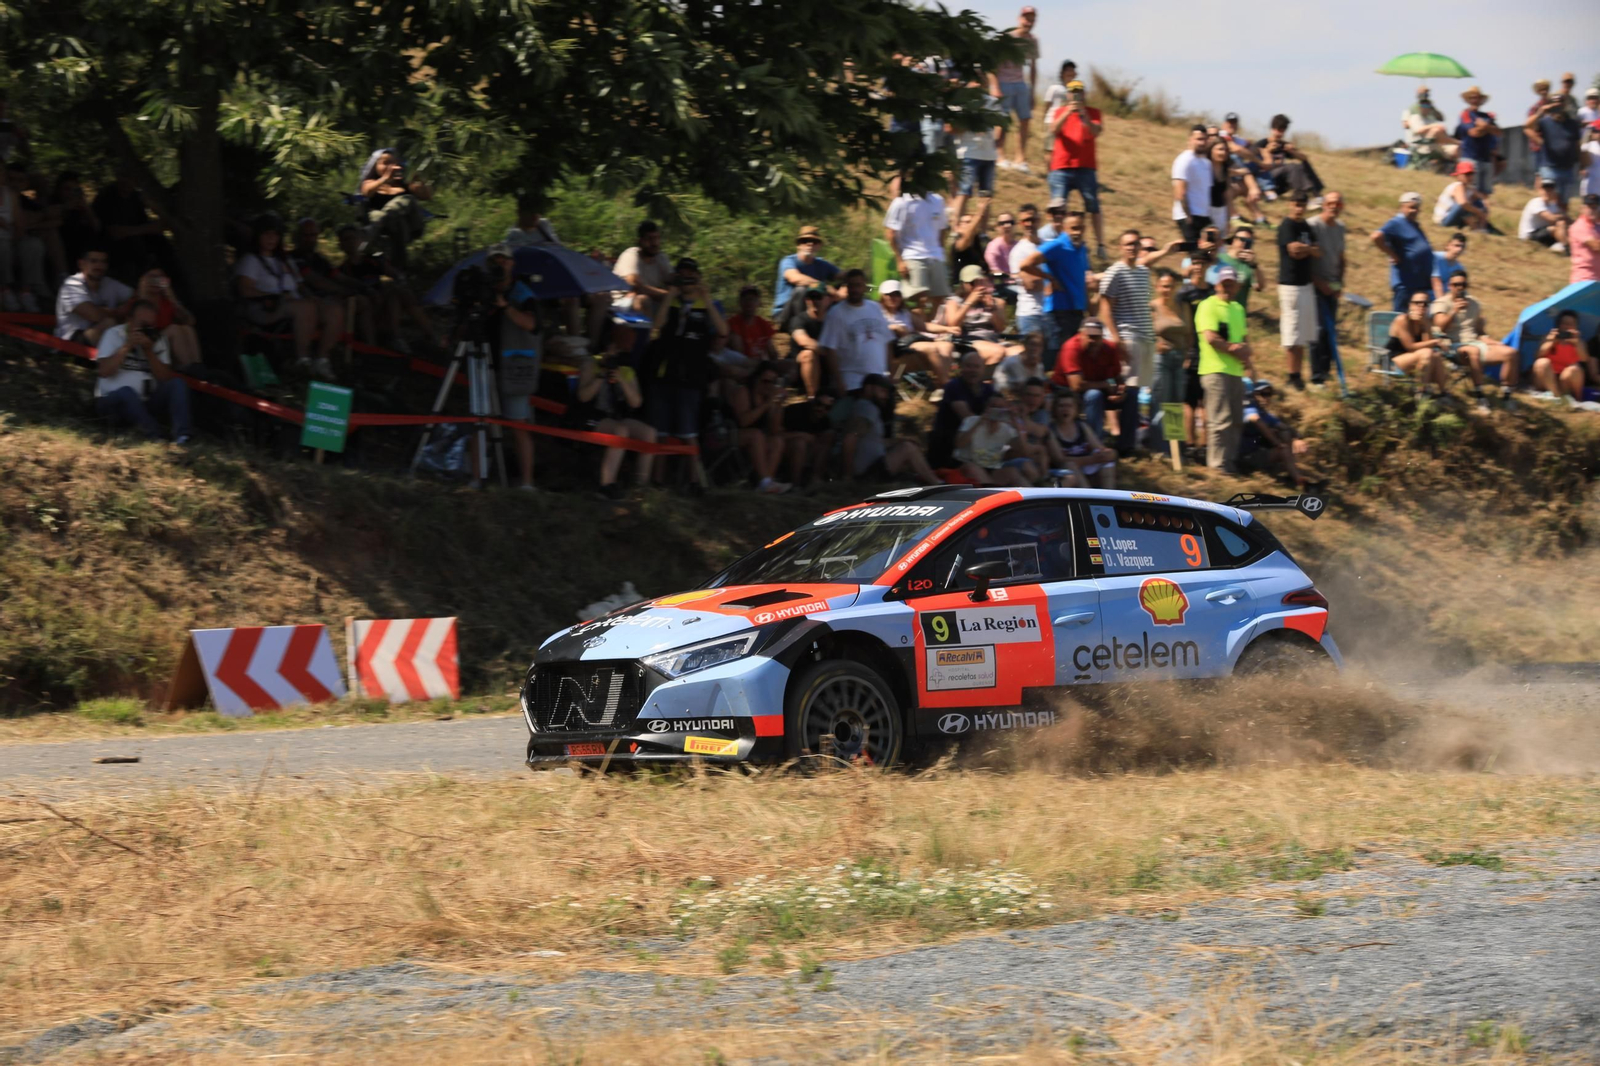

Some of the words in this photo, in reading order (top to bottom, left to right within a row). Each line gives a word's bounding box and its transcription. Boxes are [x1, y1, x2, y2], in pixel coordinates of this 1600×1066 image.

[842, 505, 944, 520] HYUNDAI
[906, 542, 930, 563] HYUNDAI
[1100, 537, 1110, 550] P.
[1111, 537, 1138, 553] Lopez
[1180, 533, 1202, 567] 9
[1106, 555, 1117, 567] D.
[1117, 555, 1154, 569] Vazquez
[776, 601, 826, 618] HYUNDAI
[931, 615, 950, 642] 9
[960, 618, 982, 632] La
[946, 652, 975, 663] Recalvi
[948, 673, 977, 681] recoletas
[978, 672, 994, 680] salud
[673, 719, 734, 731] HYUNDAI
[974, 711, 1056, 730] HYUNDAI
